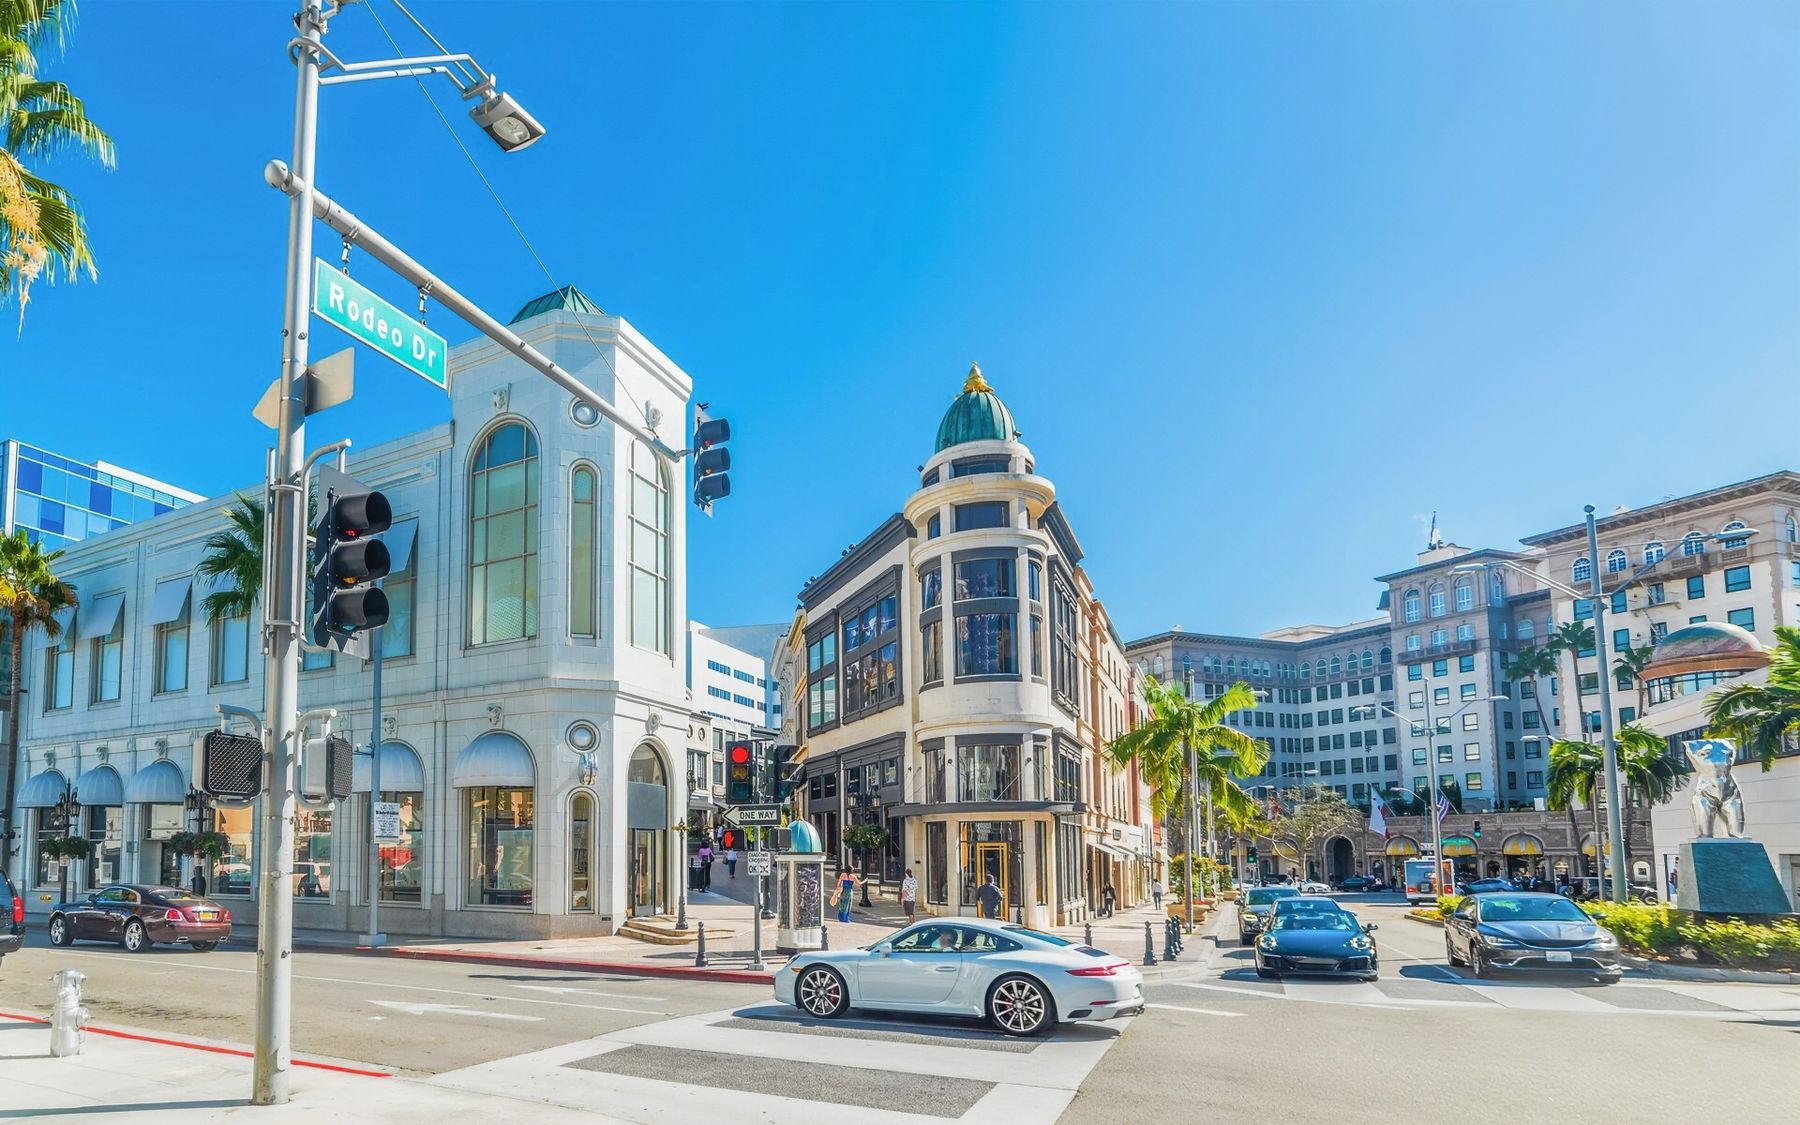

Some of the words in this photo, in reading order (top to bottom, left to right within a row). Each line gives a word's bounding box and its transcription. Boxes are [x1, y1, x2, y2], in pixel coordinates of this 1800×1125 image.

[329, 282, 403, 347] Rodeo
[412, 334, 436, 367] Dr
[740, 811, 756, 819] ONE
[758, 811, 774, 819] WAY
[749, 865, 758, 873] OK
